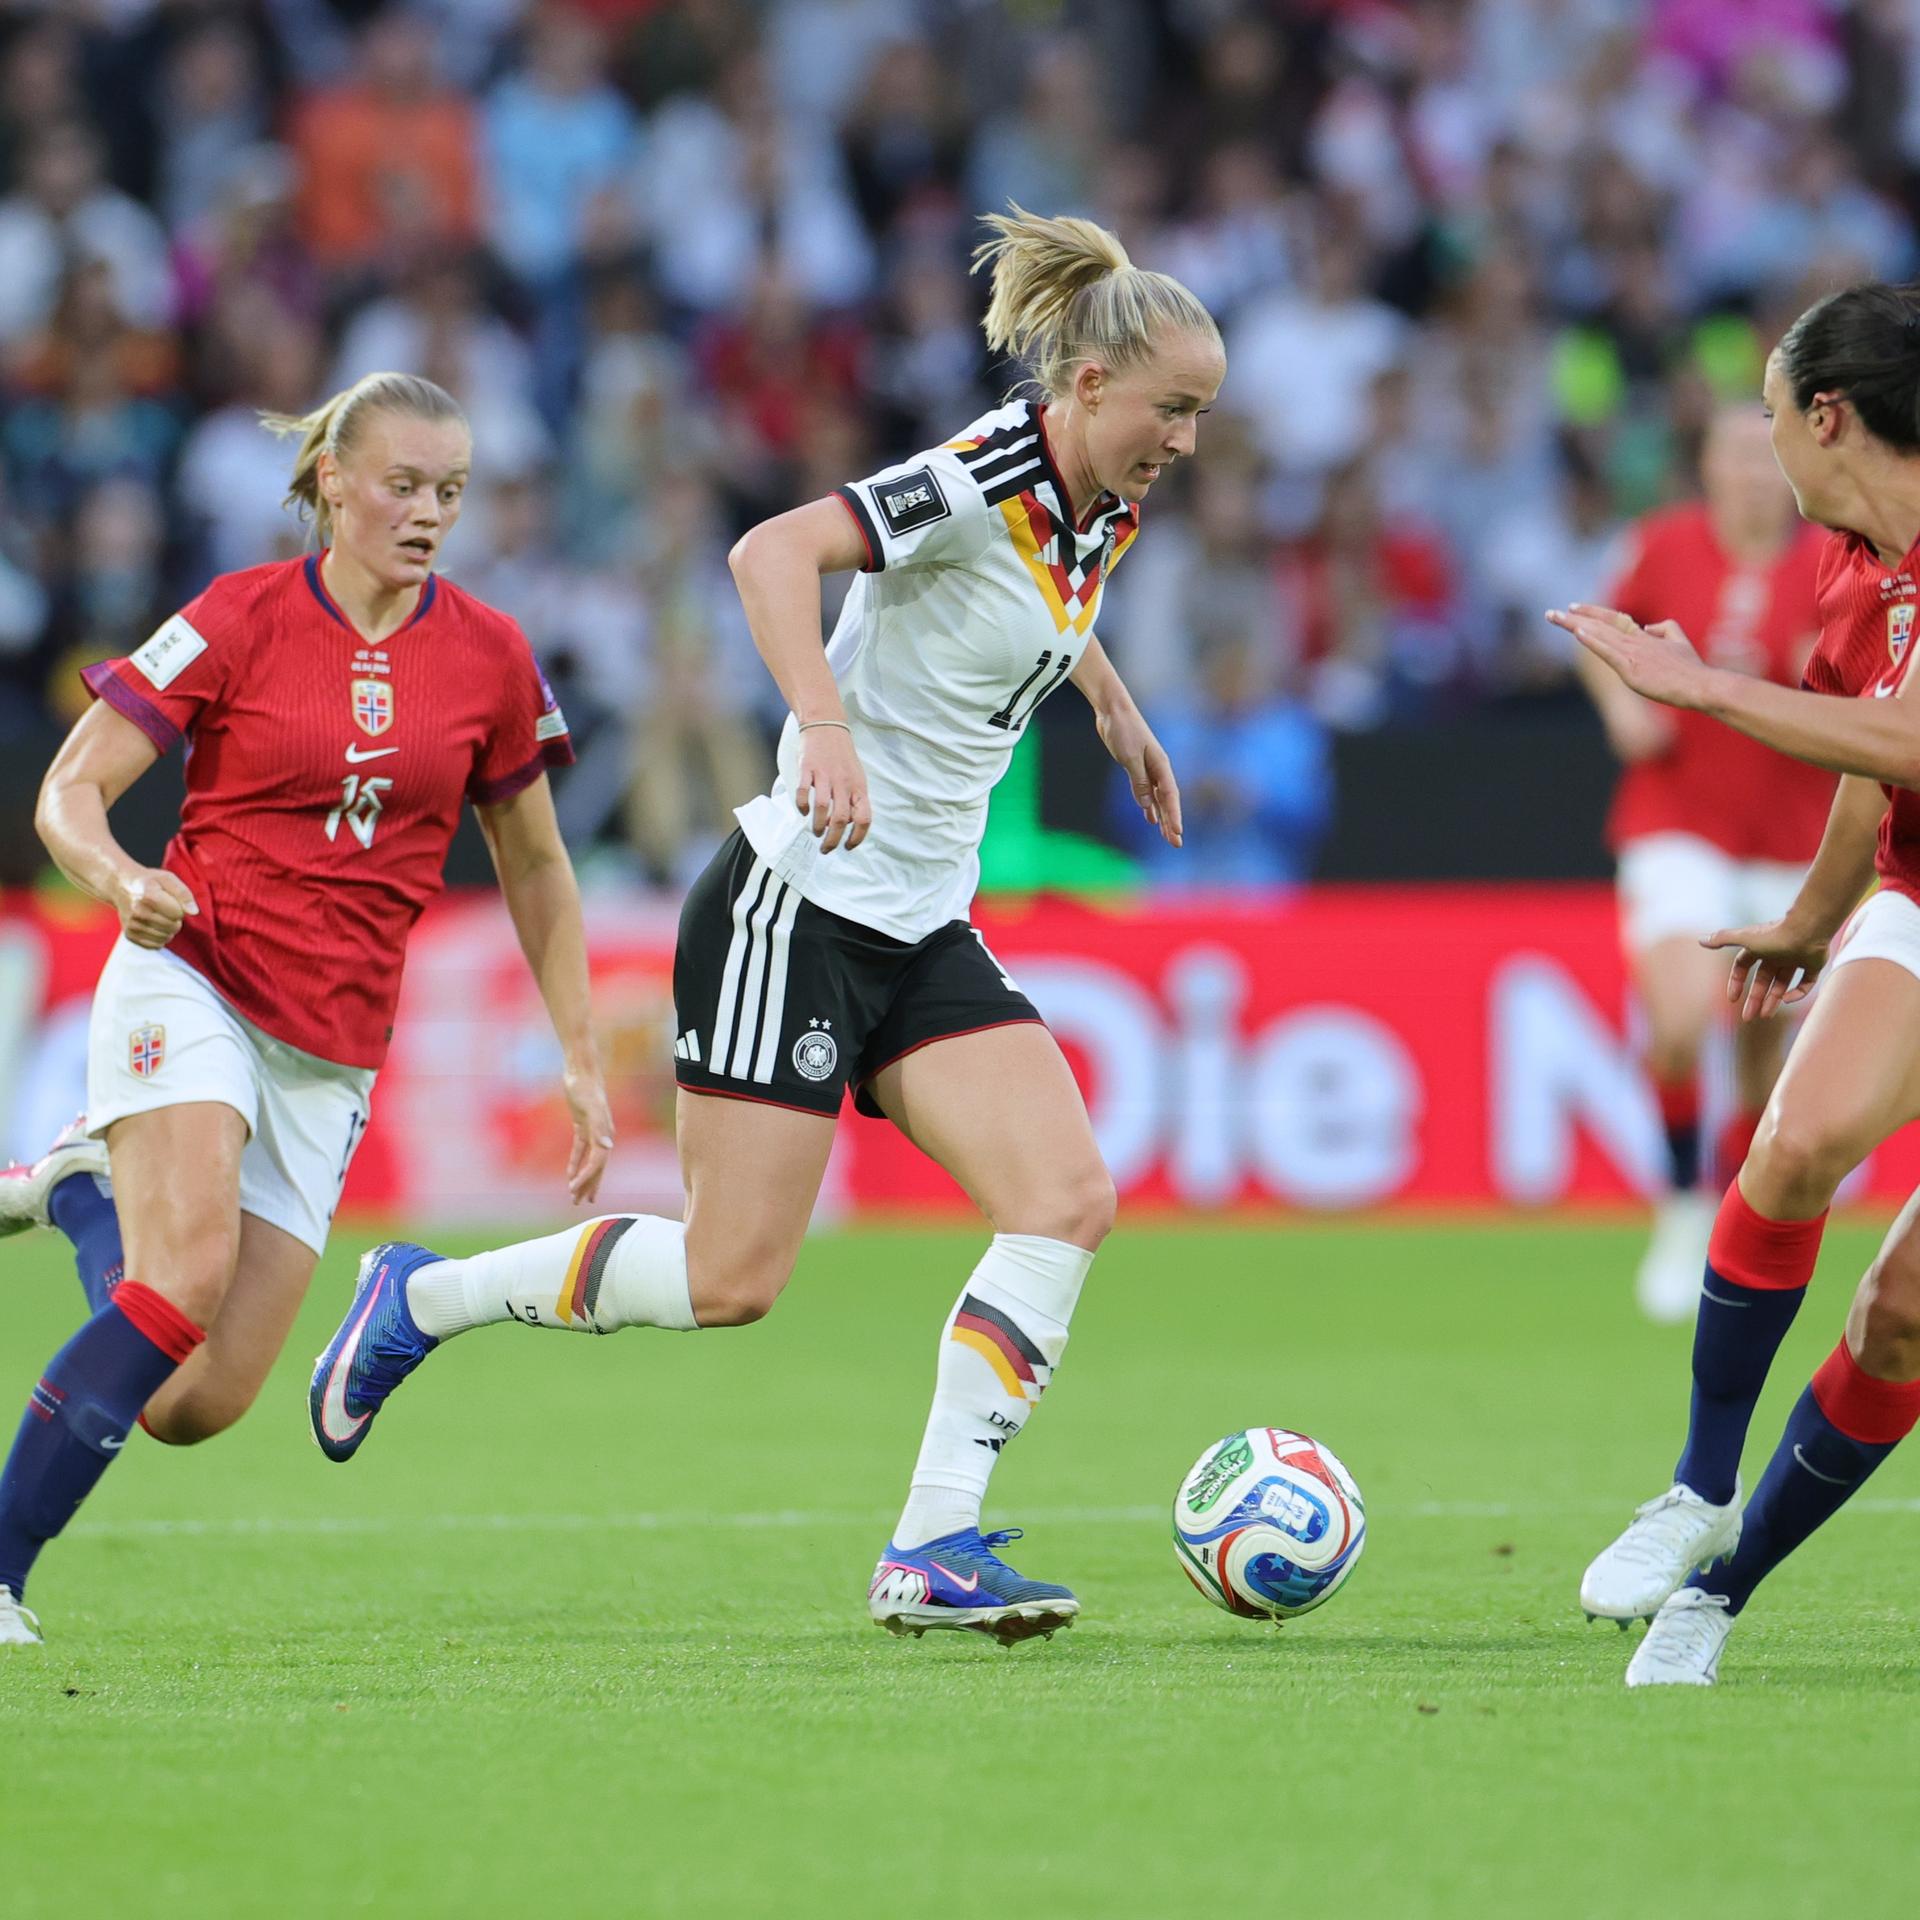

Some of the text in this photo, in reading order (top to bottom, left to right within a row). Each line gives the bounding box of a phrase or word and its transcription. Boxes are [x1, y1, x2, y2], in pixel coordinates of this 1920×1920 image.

[987, 650, 1072, 731] 11
[989, 1410, 1022, 1439] DF
[1201, 1459, 1247, 1504] TRIONDA
